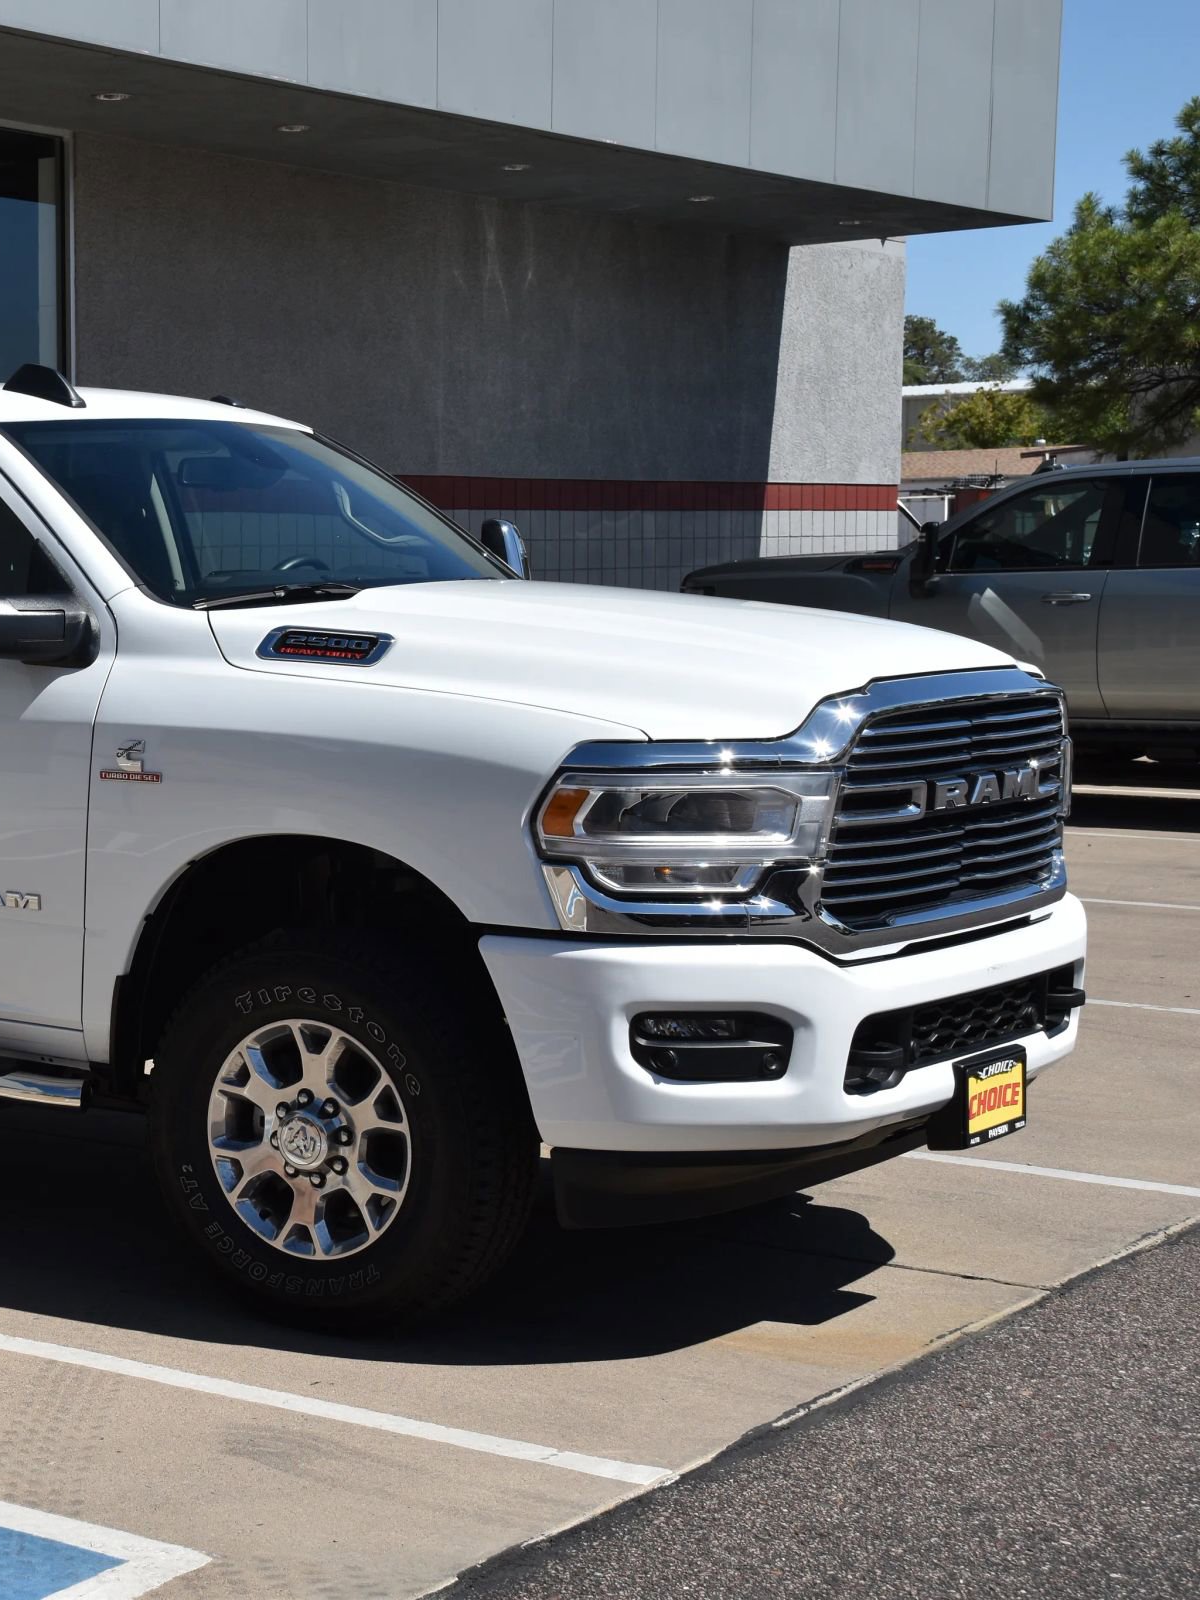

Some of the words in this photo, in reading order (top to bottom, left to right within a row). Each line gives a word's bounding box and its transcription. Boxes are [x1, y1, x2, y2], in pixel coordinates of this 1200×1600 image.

[284, 634, 371, 650] 2500
[280, 647, 324, 656] HEAVY
[325, 651, 365, 660] DUTY
[102, 772, 128, 780] TURBO
[129, 773, 159, 782] DIESEL
[934, 768, 1033, 811] RAM
[234, 984, 422, 1098] Firestone
[978, 1060, 1015, 1080] CHOICE
[969, 1082, 1021, 1121] CHOICE
[988, 1123, 1009, 1139] PAYSON
[202, 1220, 383, 1297] TRANSFORCE
